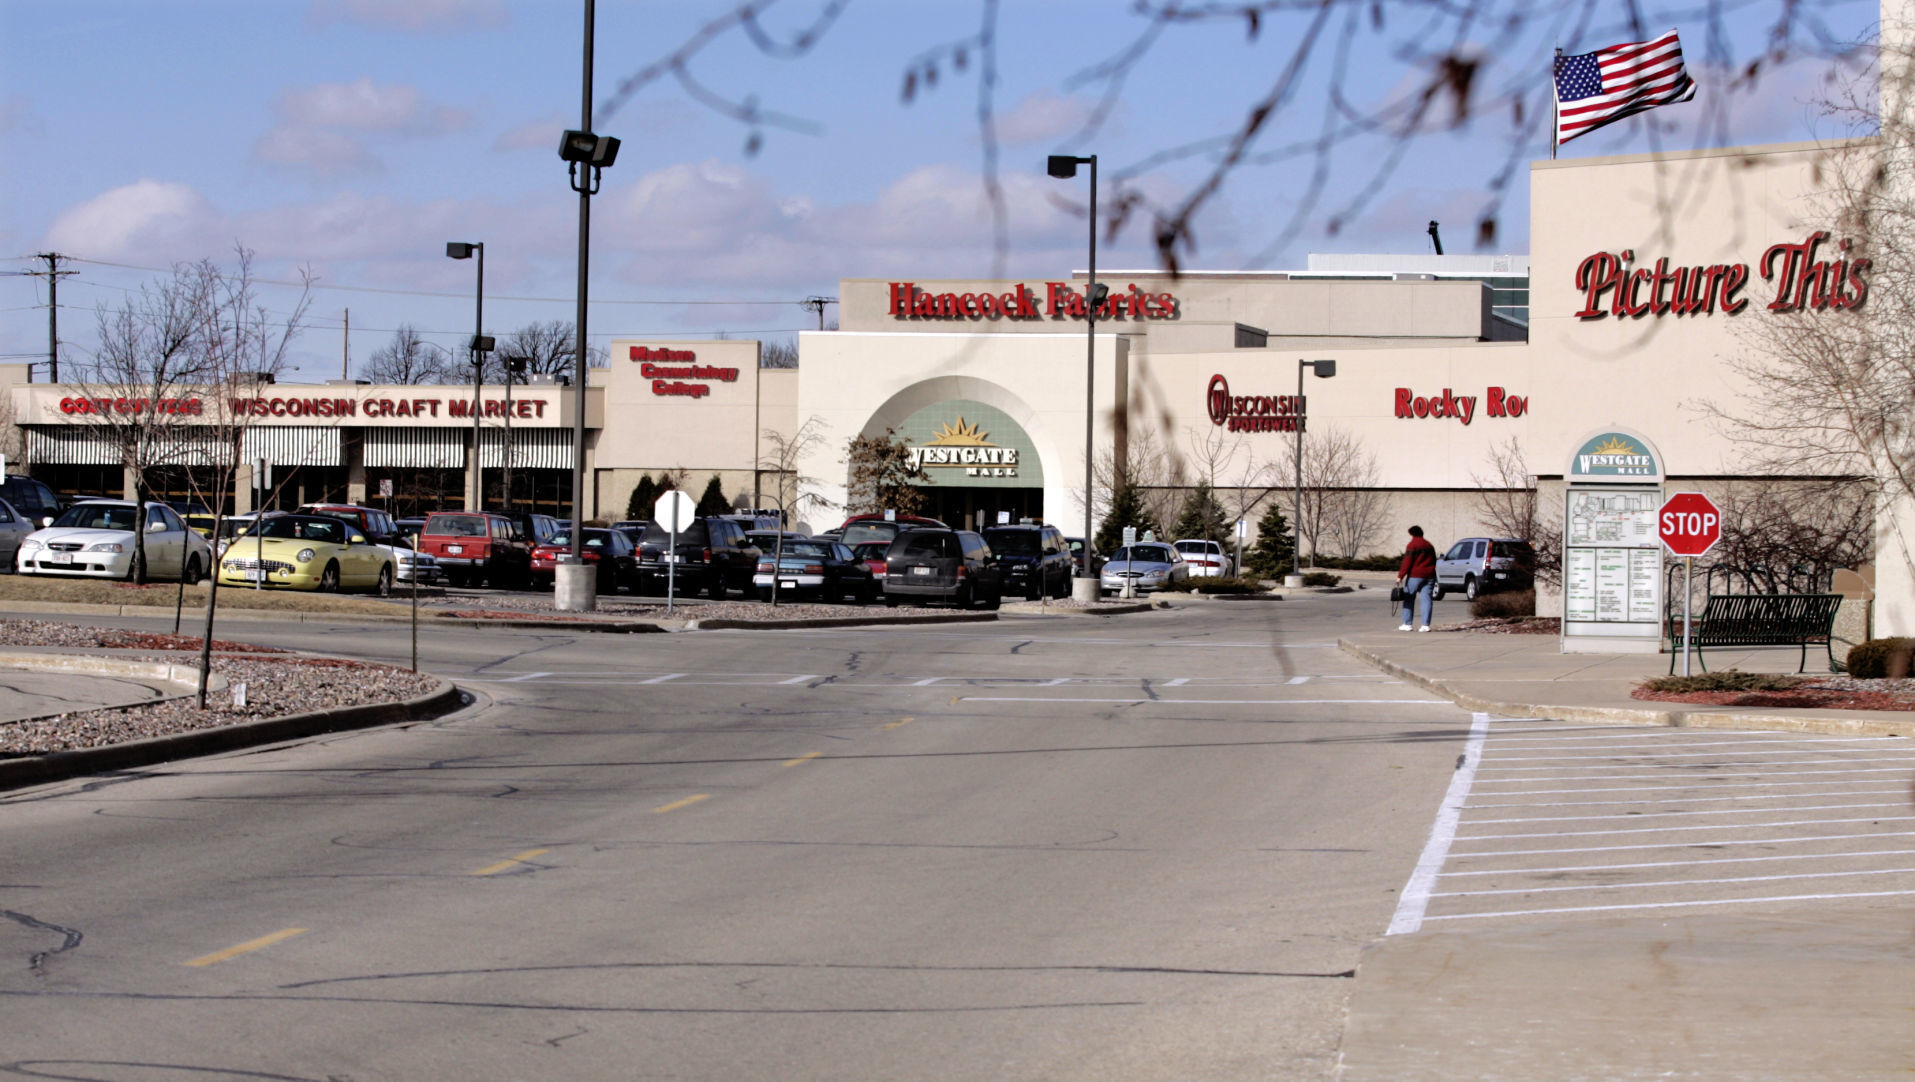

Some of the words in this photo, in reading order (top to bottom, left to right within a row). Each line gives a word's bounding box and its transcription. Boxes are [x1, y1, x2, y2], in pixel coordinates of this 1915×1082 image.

[1575, 250, 1747, 319] Picture
[1760, 231, 1872, 311] This
[888, 282, 1037, 316] Hancock
[228, 398, 356, 417] WISCONSIN
[363, 399, 442, 418] CRAFT
[449, 399, 548, 418] MARKET
[1208, 386, 1306, 420] WISCONSIN
[1395, 387, 1476, 425] Rocky
[966, 467, 1017, 477] MALL
[1580, 454, 1650, 473] WESTGATE
[1618, 467, 1650, 475] MALL
[1662, 512, 1717, 536] STOP
